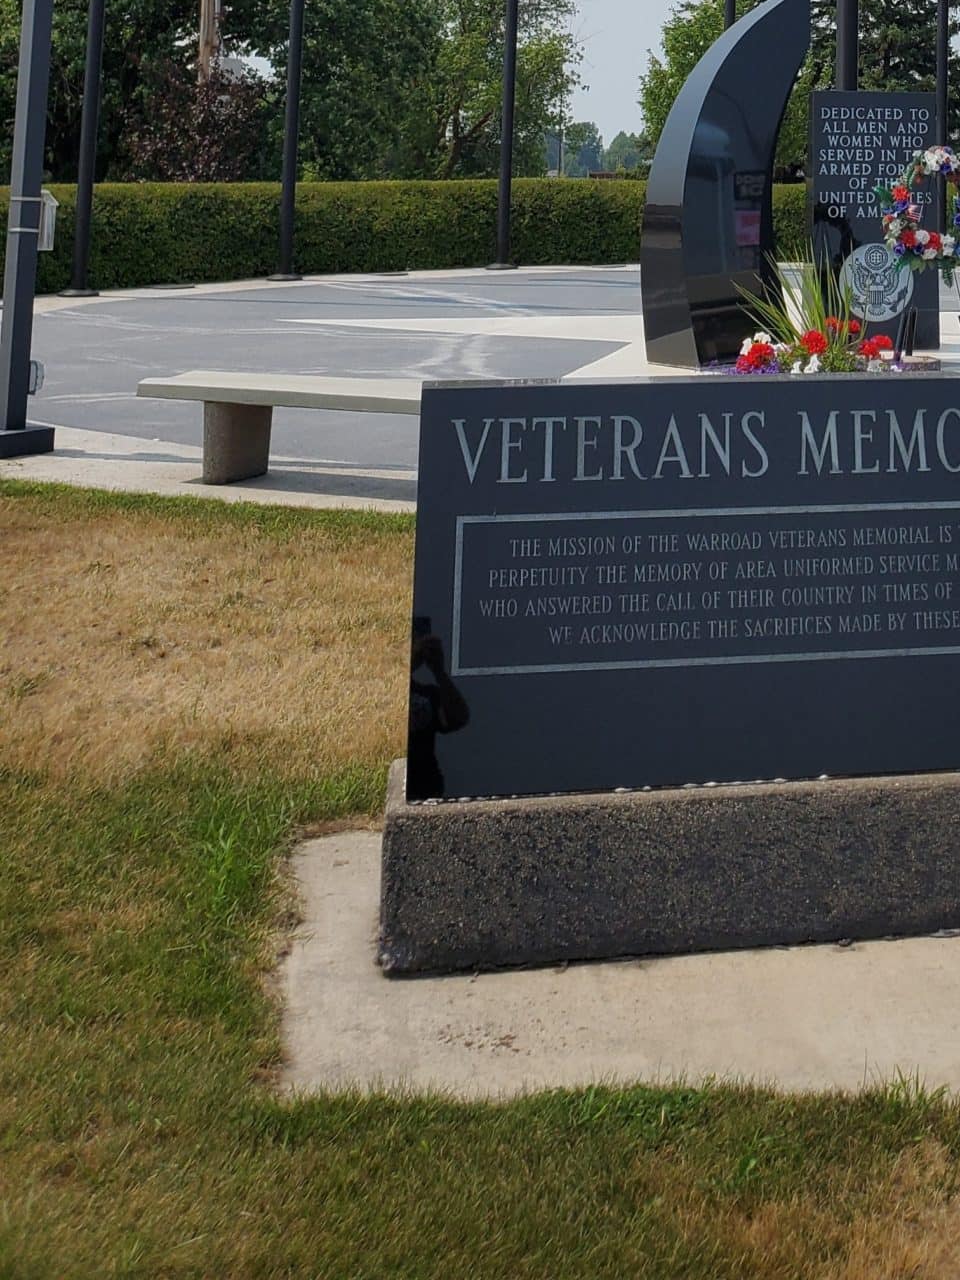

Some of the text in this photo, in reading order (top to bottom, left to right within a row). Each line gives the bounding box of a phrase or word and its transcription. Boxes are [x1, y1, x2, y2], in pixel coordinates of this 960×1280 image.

[821, 108, 929, 121] DEDICATED TO
[822, 121, 928, 134] ALL MEN AND
[828, 135, 923, 148] WOMEN WHO
[819, 149, 874, 161] SERVED
[881, 150, 896, 161] IN
[819, 164, 872, 176] ARMED
[849, 178, 867, 190] OF
[819, 192, 875, 203] UNITED
[828, 206, 847, 218] OF
[451, 410, 770, 485] VETERANS
[509, 537, 541, 558] THE
[548, 535, 615, 557] MISSION
[622, 535, 642, 554] OF
[649, 534, 680, 553] THE
[686, 531, 762, 552] WARROAD
[768, 528, 847, 551] VETERANS
[852, 525, 934, 546] MEMORIAL
[939, 525, 952, 543] IS
[488, 566, 587, 589] PERPETUITY
[596, 566, 627, 585] THE
[633, 563, 702, 584] MEMORY
[709, 562, 729, 581] OF
[735, 560, 776, 579] AREA
[783, 555, 874, 577] UNIFORMED
[879, 553, 940, 574] SERVICE
[479, 598, 518, 618] WHO
[525, 595, 612, 616] ANSWERED
[618, 594, 650, 613] THE
[656, 592, 695, 611] CALL
[701, 591, 721, 609] OF
[727, 589, 775, 608] THEIR
[781, 585, 855, 607] COUNTRY
[861, 585, 877, 604] IN
[883, 584, 929, 602] TIMES
[934, 582, 954, 600] OF
[549, 625, 573, 645] WE
[579, 622, 701, 644] ACKNOWLEDGE
[707, 620, 738, 639] THE
[744, 616, 832, 637] SACRIFICES
[838, 614, 882, 634] MADE
[887, 613, 906, 631] BY
[912, 611, 960, 630] THESE
